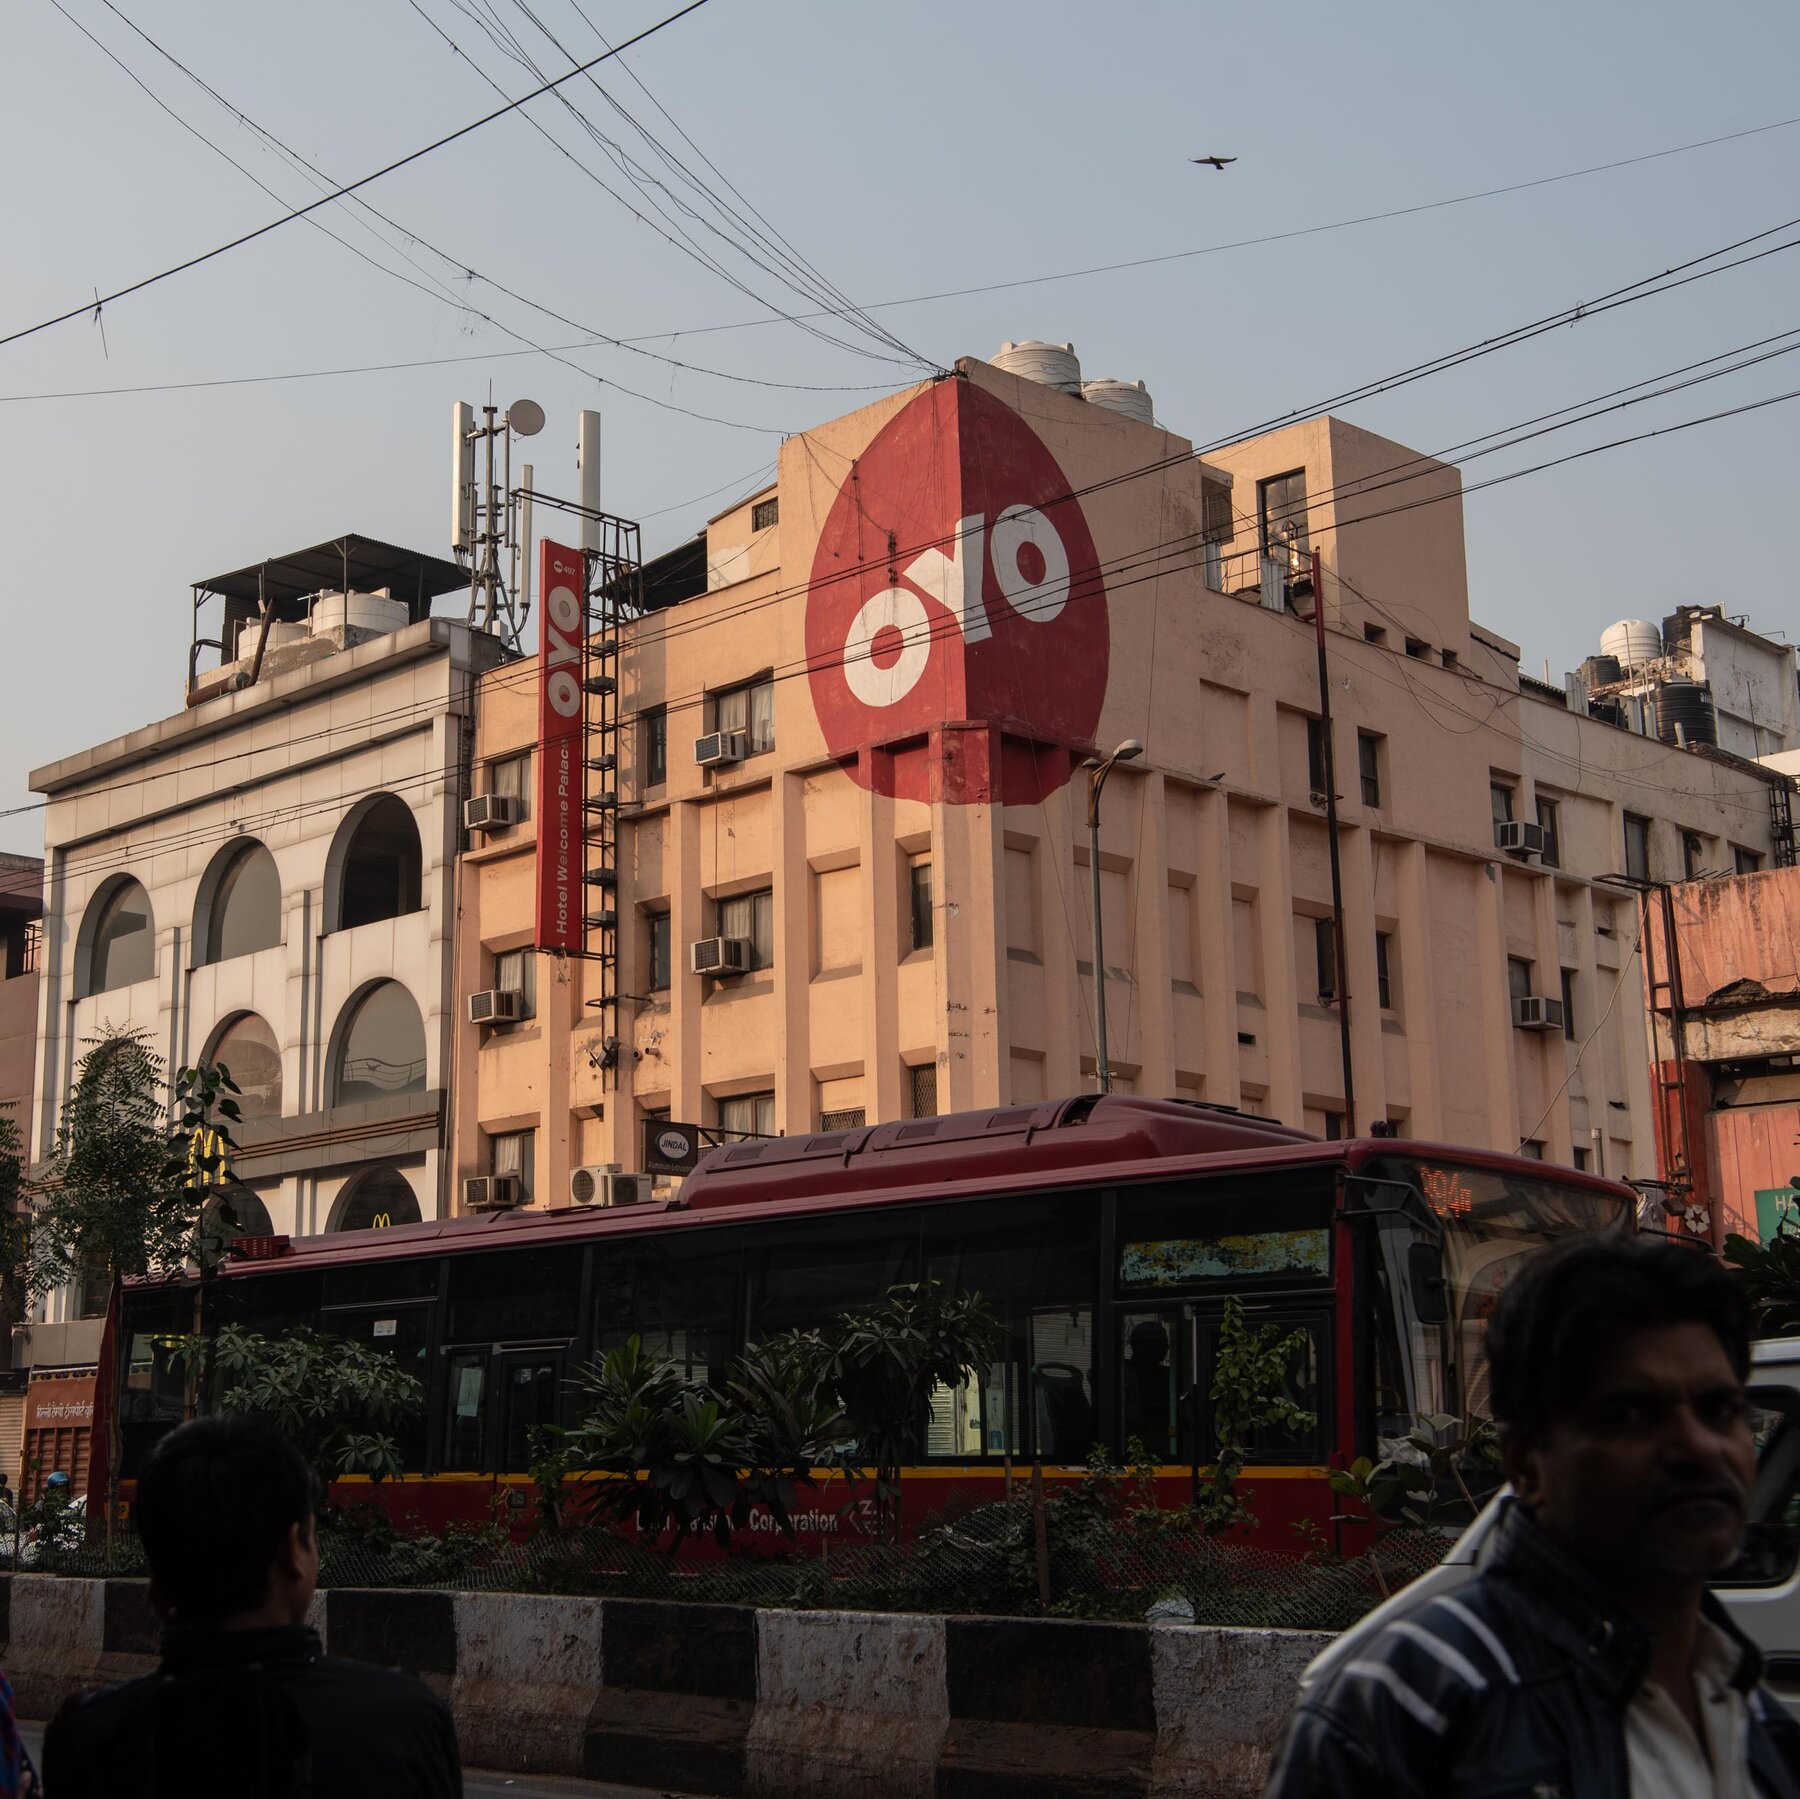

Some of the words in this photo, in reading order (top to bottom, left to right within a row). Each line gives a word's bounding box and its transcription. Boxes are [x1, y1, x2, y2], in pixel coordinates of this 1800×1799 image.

[844, 503, 1070, 708] OYO
[548, 585, 581, 718] OYO
[558, 738, 569, 797] Palace
[556, 801, 569, 882] Welcome
[556, 885, 568, 934] Hotel
[661, 1139, 688, 1152] JINDAL
